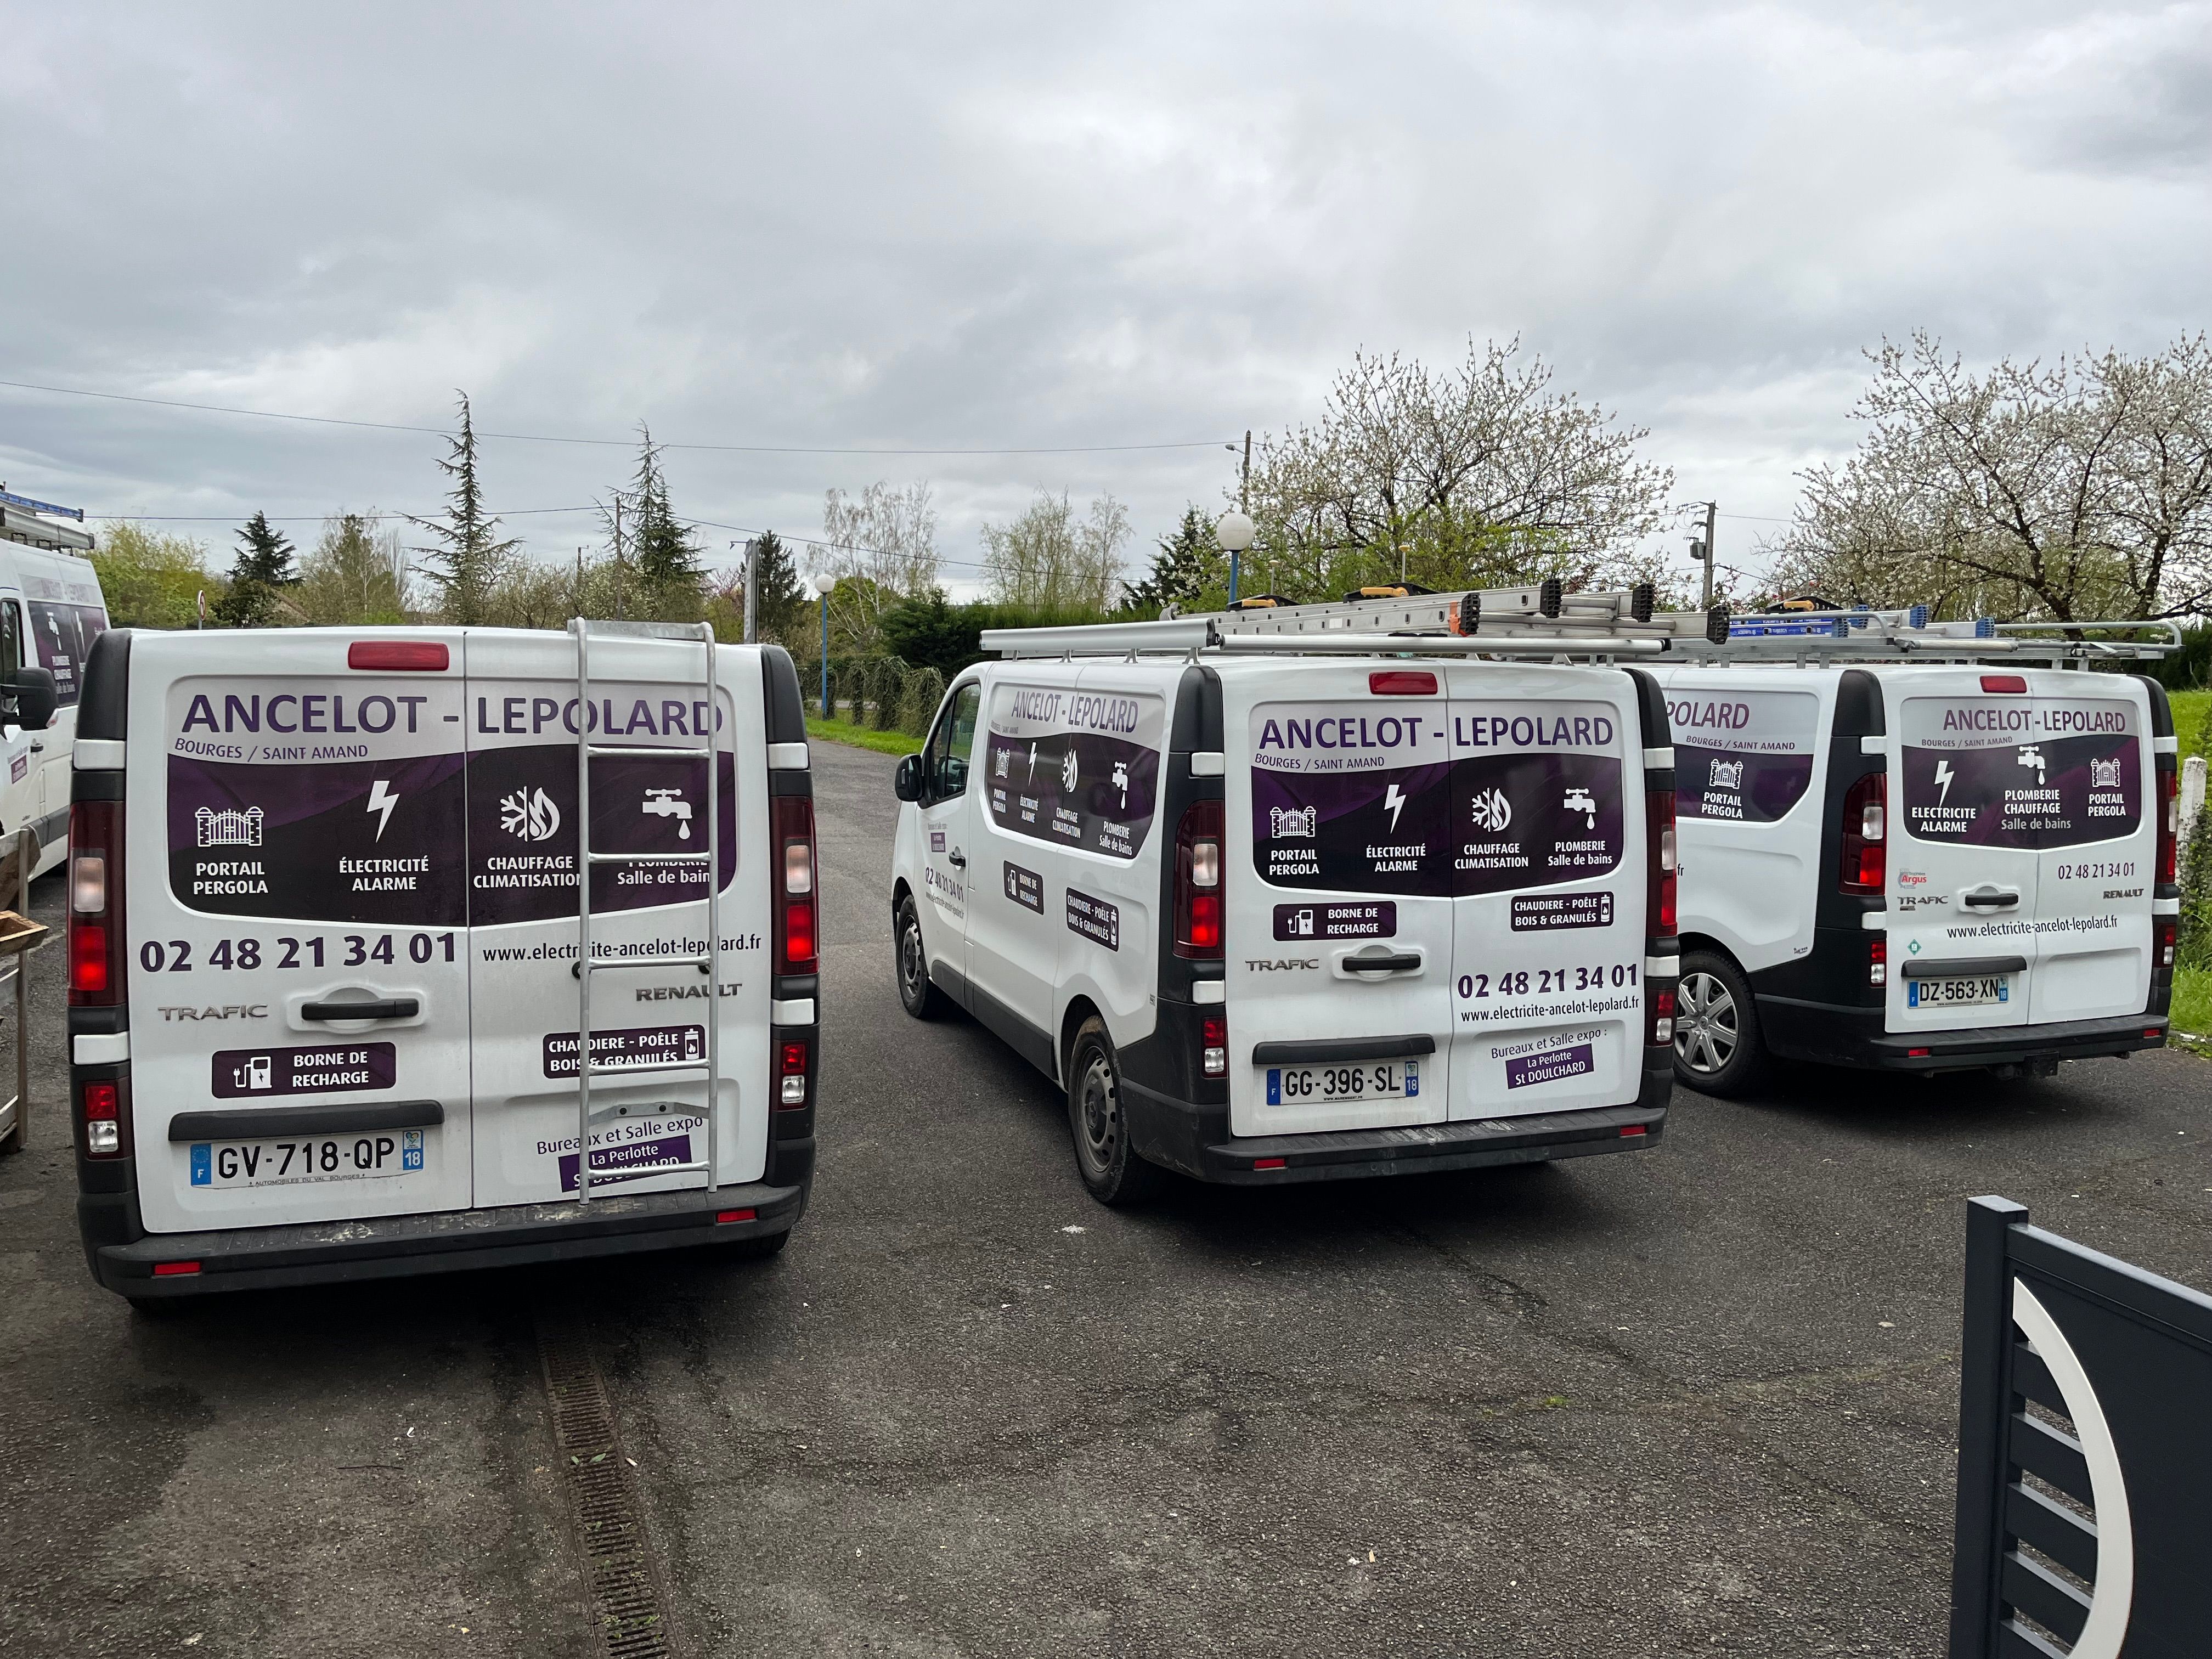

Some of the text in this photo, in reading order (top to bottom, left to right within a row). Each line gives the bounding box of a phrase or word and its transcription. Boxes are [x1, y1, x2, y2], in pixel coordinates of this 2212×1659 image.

[182, 695, 723, 736] ANCELOT LEPOLARD
[1012, 691, 1138, 733] ANCELOT LEPOLARD
[1667, 701, 1750, 729] POLARD
[1943, 710, 2125, 732] ANCELOT LEPOLARD
[1259, 716, 1613, 749] ANCELOT LEPOLARD
[174, 738, 368, 762] BOURGES / SAINT AMAND
[1686, 735, 1795, 751] BOURGES / SAINT AMAND
[1921, 739, 1955, 747] BOURGES
[1957, 740, 1962, 748] /
[1987, 736, 2013, 746] AMAND
[1255, 753, 1384, 771] BOURGES / SAINT AMAND
[994, 788, 1006, 801] PORTAIL
[1020, 793, 1039, 811] ÉLECTRICITÉ
[1703, 792, 1742, 806] PORTAIL
[2005, 789, 2059, 801] PLOMBERIE
[2089, 794, 2124, 804] PORTAIL
[992, 800, 1006, 813] PERGOLA
[1701, 804, 1743, 819] PERGOLA
[1911, 807, 1976, 819] ELECTRICITE
[2004, 803, 2061, 814] CHAUFFAGE
[2087, 805, 2126, 817] PERGOLA
[1022, 810, 1035, 823] ALARME
[1056, 807, 1078, 823] CHAUFFAGE
[1052, 820, 1081, 839] CLIMATISATION
[1103, 821, 1130, 839] PLOMBERIE
[1921, 821, 1967, 832] ALARME
[2001, 818, 2071, 830] Salle de bains
[1099, 834, 1132, 856] Salle de bains
[1366, 843, 1426, 858] ÉLECTRICITÉ
[1464, 843, 1520, 855] CHAUFFAGE
[1555, 840, 1606, 852] PLOMBERIE
[1271, 849, 1317, 861] PORTAIL
[1548, 853, 1612, 867] Salle de bains
[196, 862, 265, 876] PORTAIL
[339, 855, 429, 873] ÉLECTRICITÉ
[487, 856, 573, 871] CHAUFFAGE
[1269, 863, 1319, 875] PERGOLA
[1374, 860, 1418, 872] ALARME
[1454, 857, 1528, 870] CLIMATISATION
[2058, 862, 2135, 879] 02 48 21 34 01
[352, 877, 416, 891] ALARME
[617, 869, 710, 885] Salle de bain
[926, 867, 964, 902] 02 48 21 34 01
[1019, 873, 1037, 890] BORNE DE
[1901, 875, 1927, 885] Argus
[193, 879, 268, 895] PERGOLA
[2103, 888, 2144, 900] RENAULT
[1019, 889, 1037, 906] RECHARGE
[1514, 896, 1597, 912] CHAUDIERE POÊLE
[1897, 896, 1948, 905] TRAFIC
[1067, 895, 1109, 922] CHAUDIERE POÊLE
[1328, 908, 1378, 919] BORNE DE
[1068, 912, 1109, 940] BOIS & GRANULÉS
[1515, 911, 1596, 926] BOIS & GRANULÉS
[1327, 923, 1379, 934] RECHARGE
[1946, 915, 2118, 939] www.electricite-ancelot-lepolard.fr
[140, 932, 455, 972] 02 48 21 34 01
[483, 934, 761, 962] www.electrite-ancelot-leplard.fr
[1245, 958, 1319, 972] TRAFIC
[1458, 963, 1637, 998] 02 48 21 34 01
[636, 984, 742, 1002] RENAULT
[1920, 979, 1999, 1001] DZ-563-XN
[2000, 990, 2007, 999] 18
[158, 1004, 268, 1022] TRAFIC
[1461, 996, 1639, 1022] www.electricite-ancelot-lepolard.fr
[639, 1032, 679, 1047] POÊLE
[1491, 1029, 1601, 1059] Bureaux et Salle expo
[294, 1051, 368, 1067] BORNE DE
[550, 1059, 580, 1071] BOIS
[604, 1050, 678, 1065] GRANULÉS
[1527, 1051, 1572, 1068] La Perlotte
[292, 1071, 369, 1088] RECHARGE
[1515, 1060, 1585, 1085] St DOULCHARD
[1285, 1066, 1400, 1097] GG-396-SL
[1407, 1079, 1418, 1091] 18
[537, 1117, 703, 1155] Bureax et Salle expo
[198, 1137, 421, 1180] F GV-718-QP 18
[591, 1144, 658, 1166] La Perlotte
